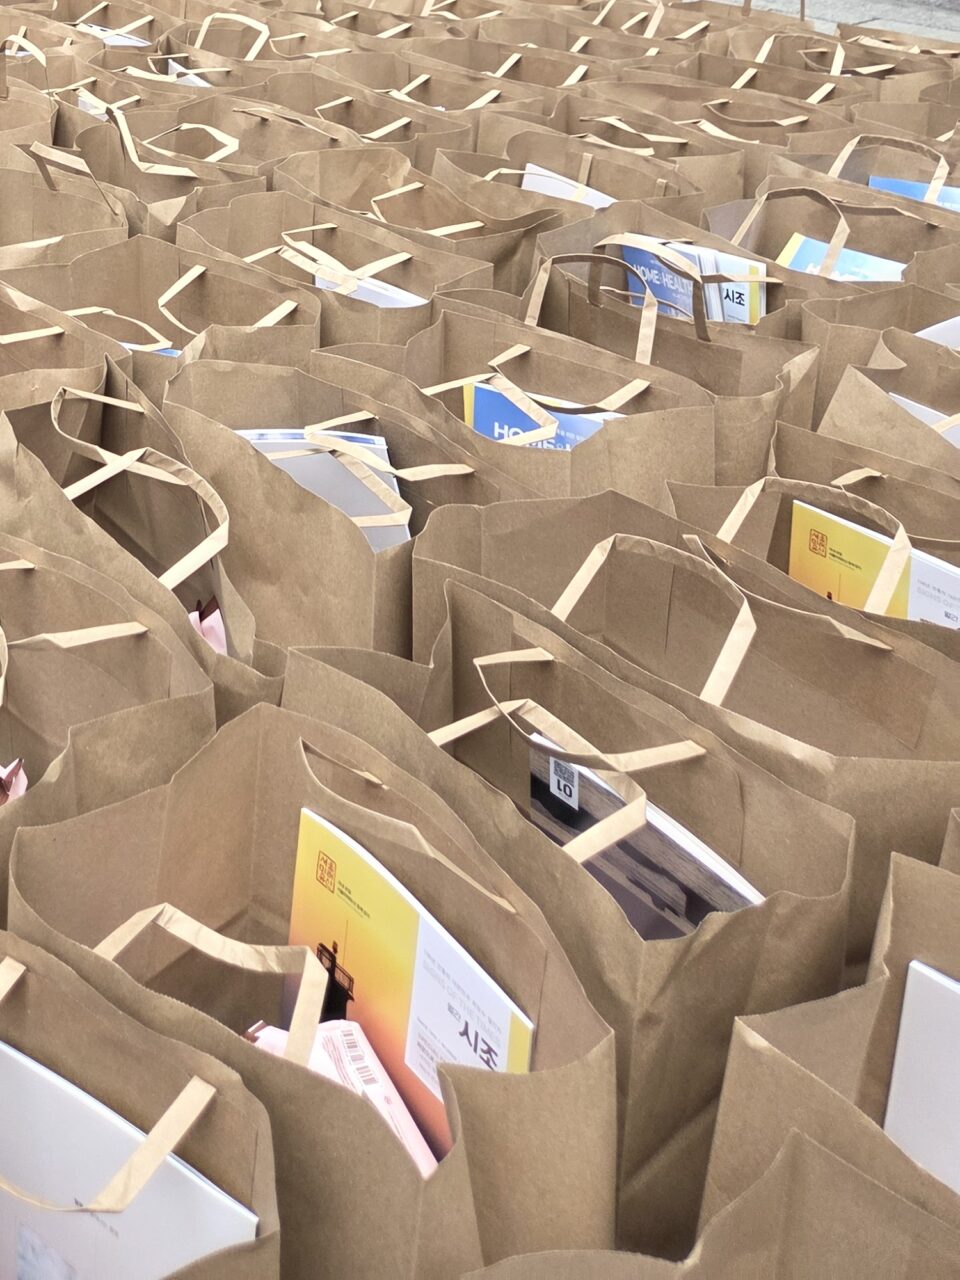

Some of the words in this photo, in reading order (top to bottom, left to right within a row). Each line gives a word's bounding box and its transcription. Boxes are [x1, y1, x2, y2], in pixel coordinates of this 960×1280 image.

[724, 287, 745, 307] 시조
[557, 779, 572, 798] 01
[458, 1019, 499, 1071] 시조
